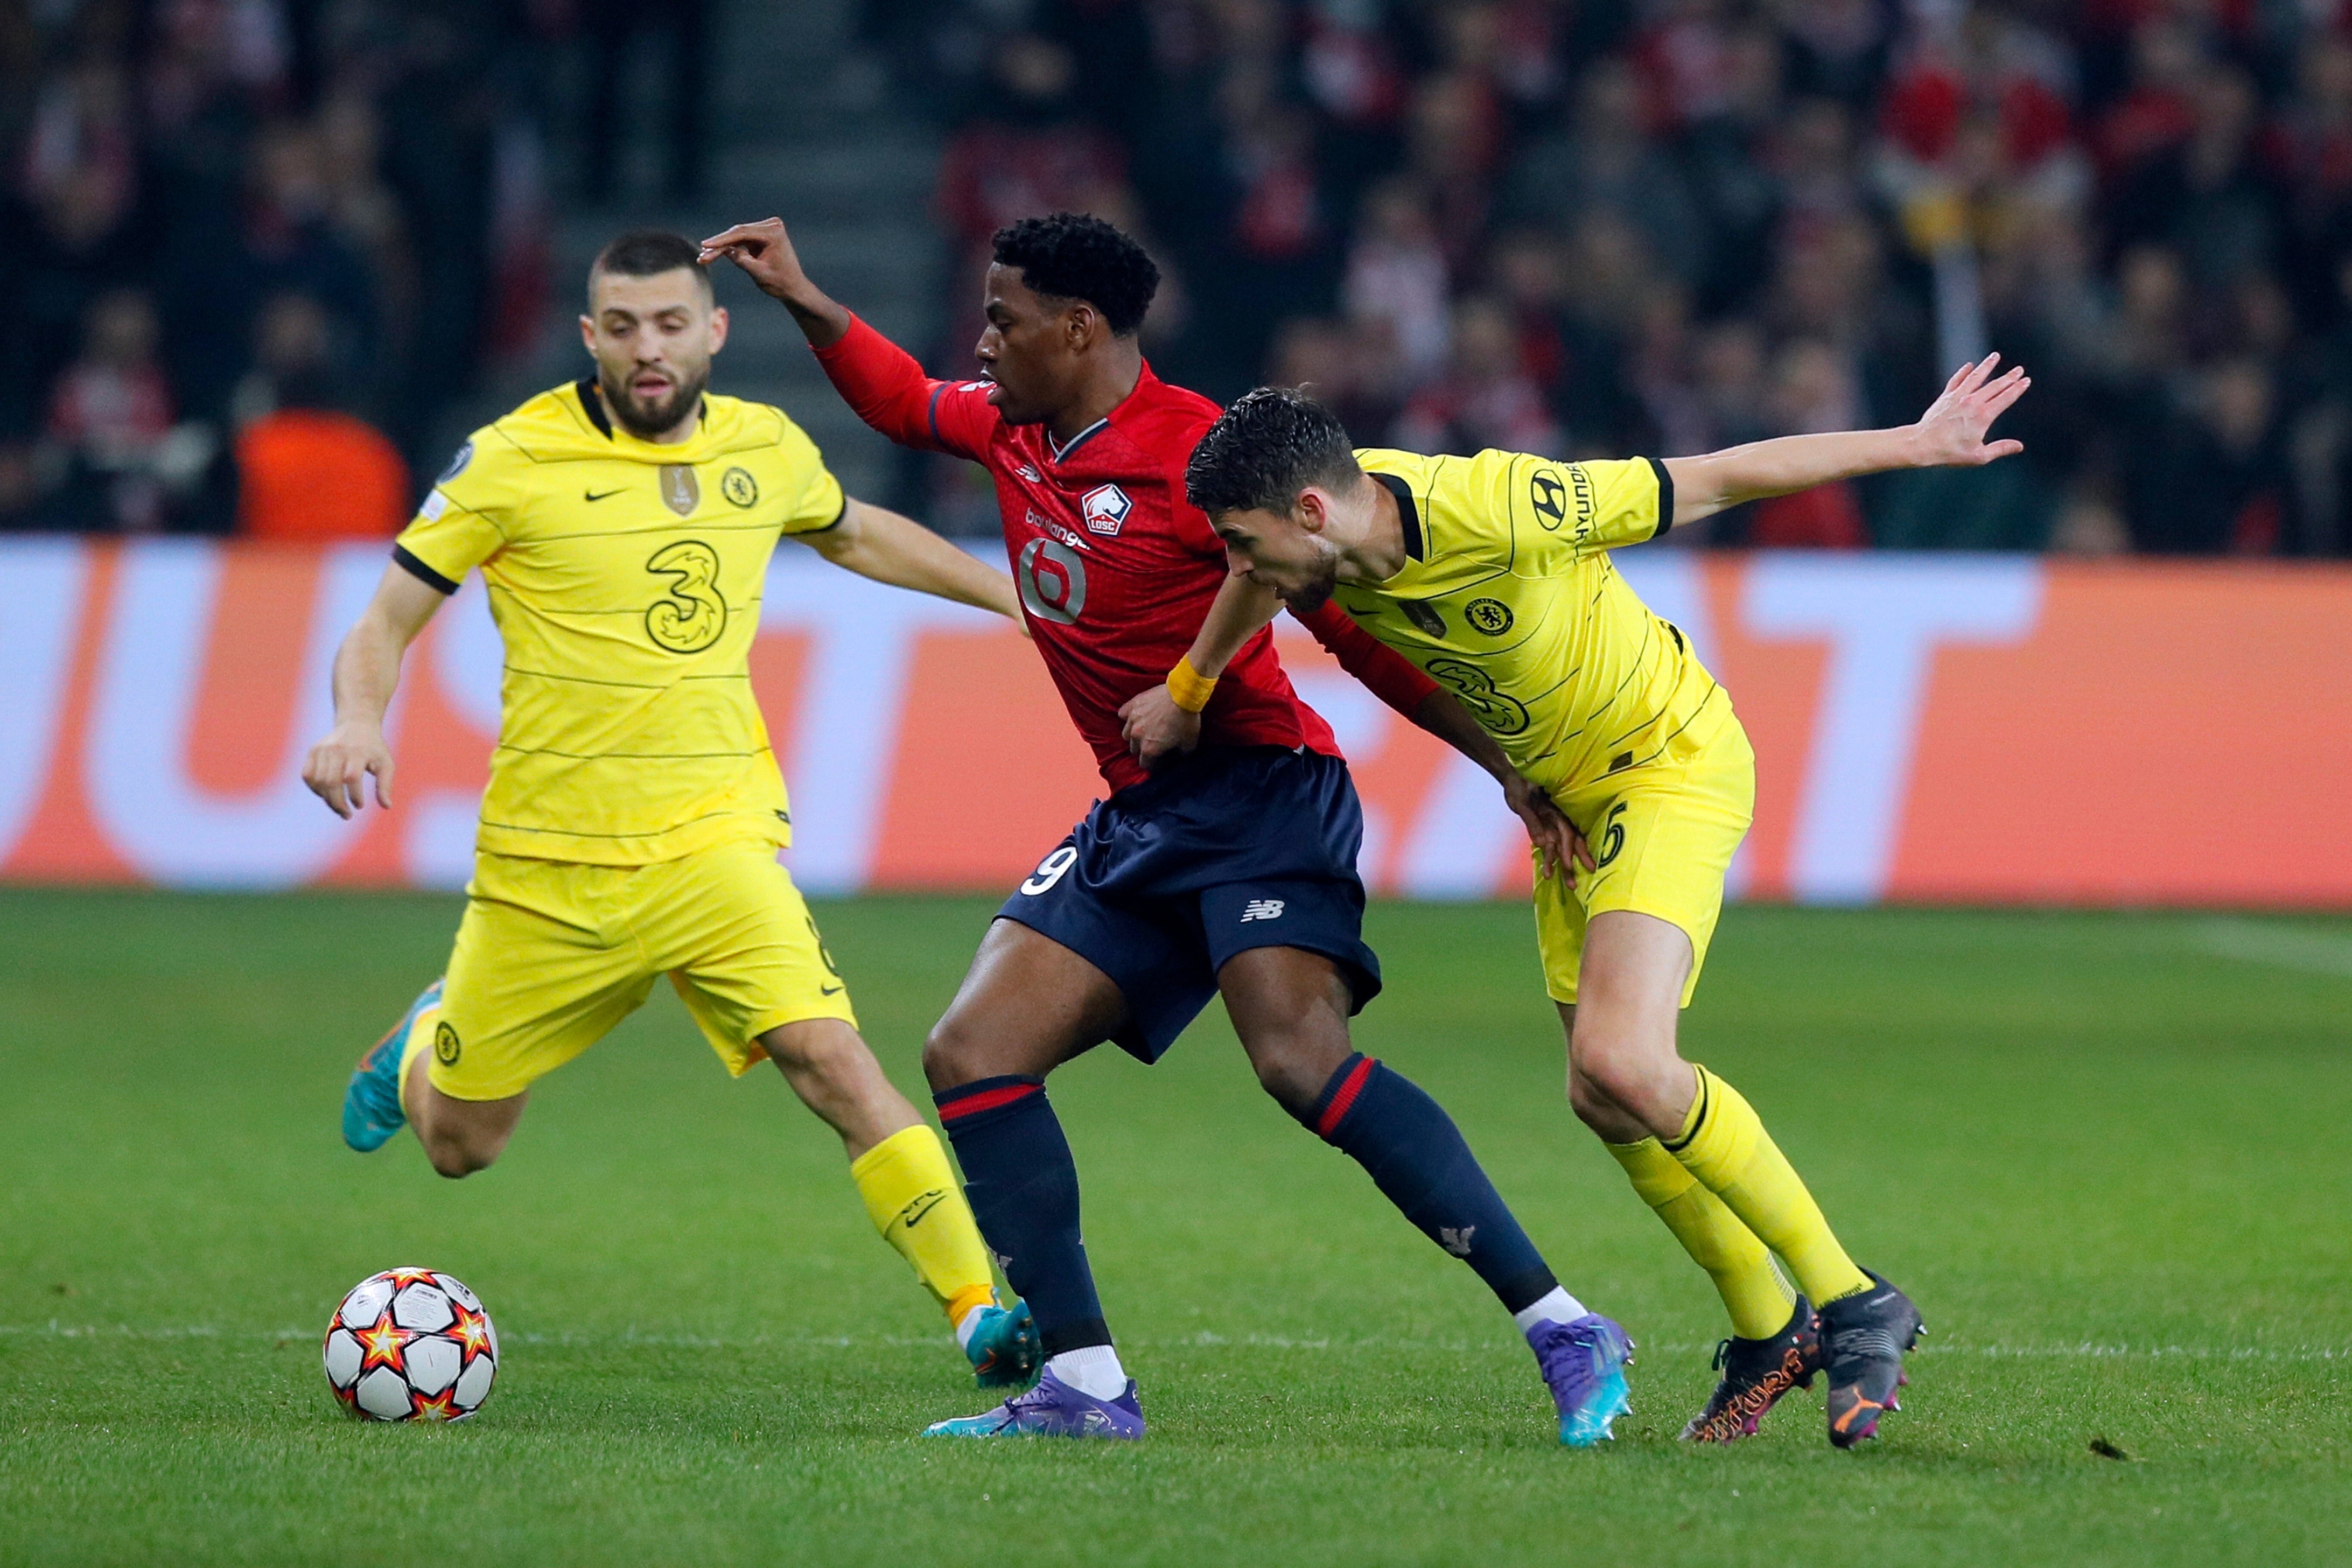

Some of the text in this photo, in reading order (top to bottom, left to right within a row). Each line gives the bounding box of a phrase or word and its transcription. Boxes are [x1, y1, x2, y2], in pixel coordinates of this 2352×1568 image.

[1091, 519, 1115, 531] LOSC
[1564, 465, 1591, 541] HYUNDA
[646, 540, 726, 654] 3
[1597, 800, 1627, 870] 5
[1020, 846, 1078, 896] 9
